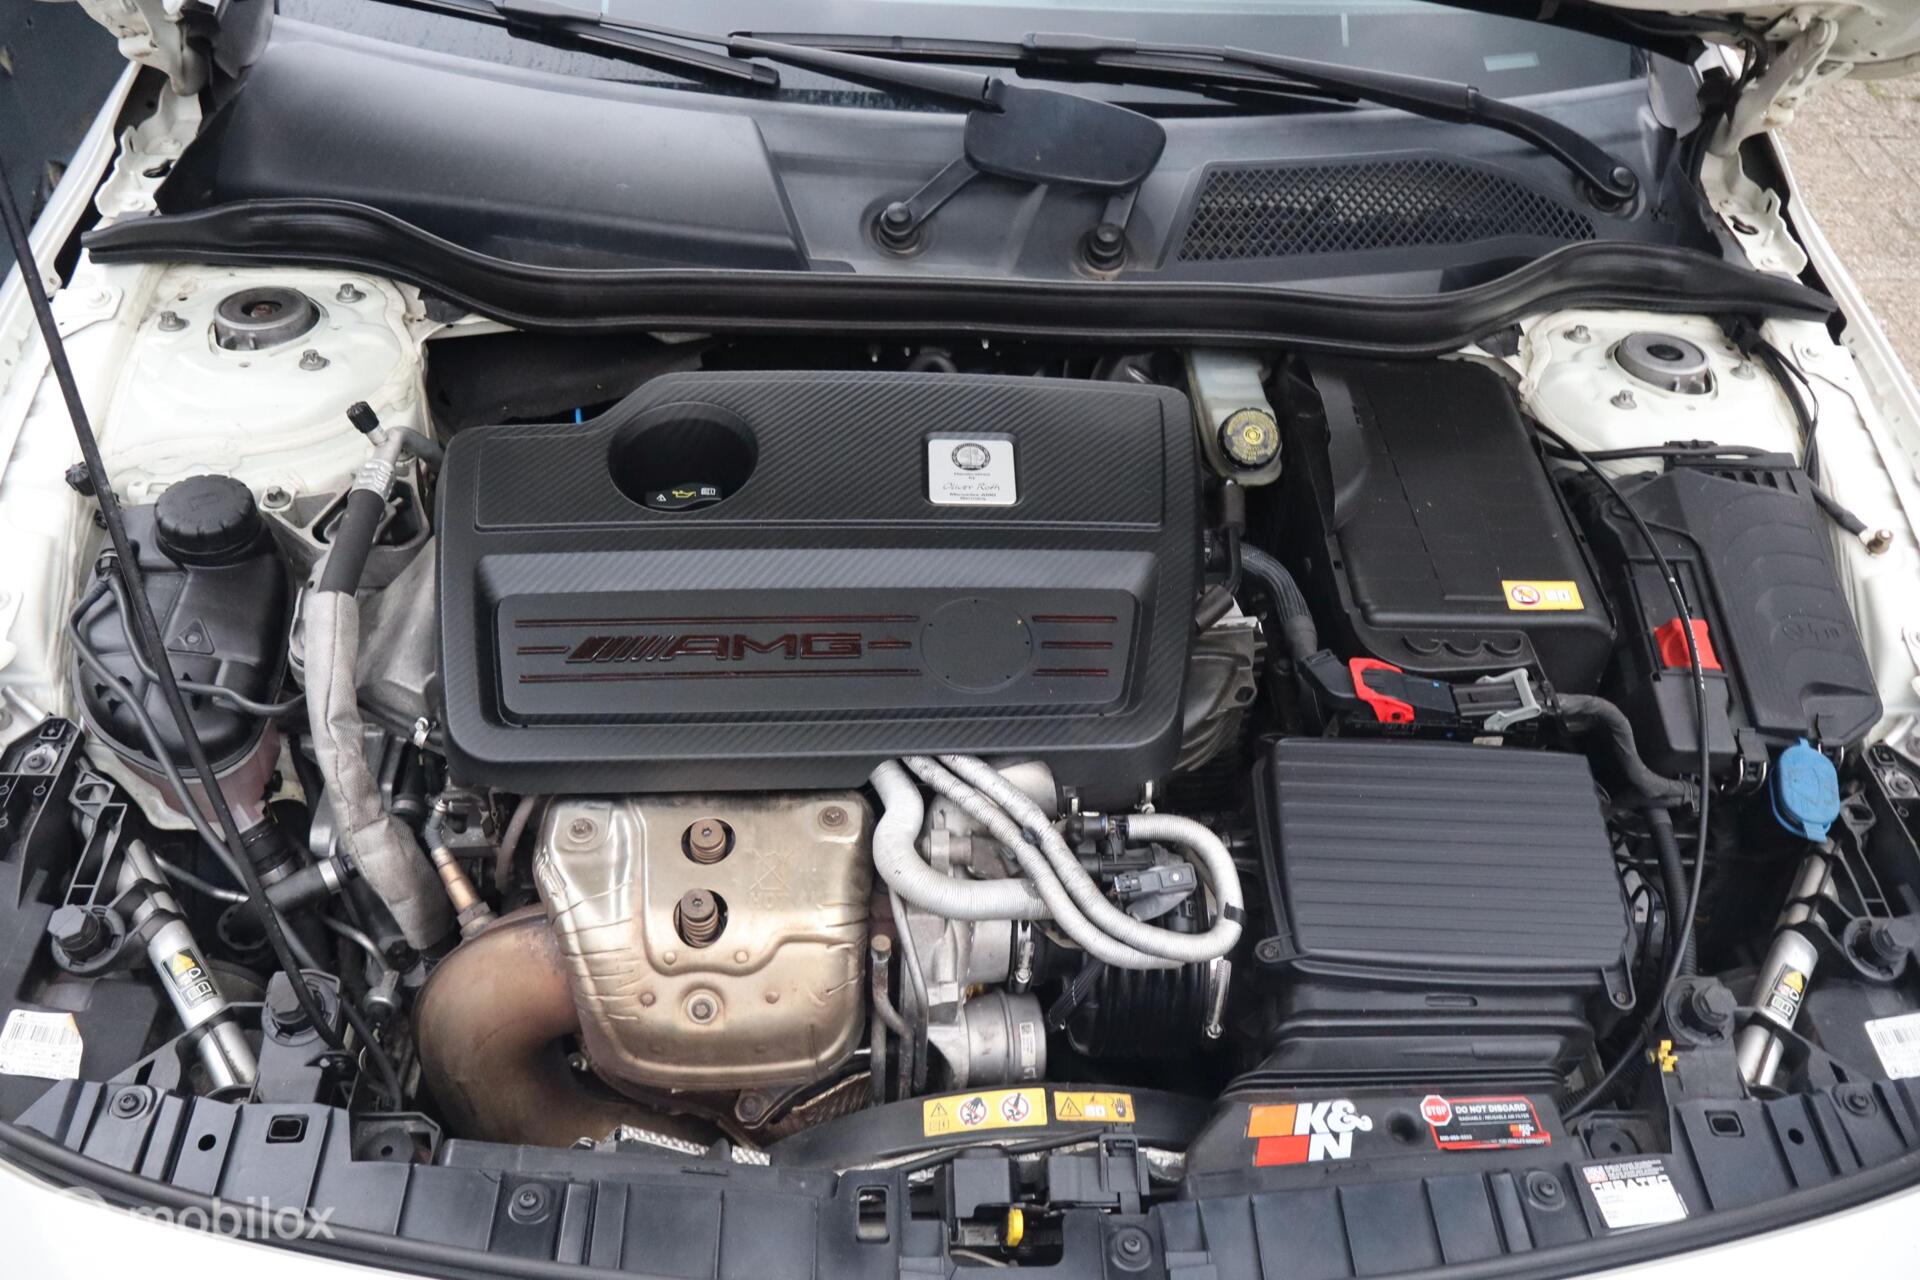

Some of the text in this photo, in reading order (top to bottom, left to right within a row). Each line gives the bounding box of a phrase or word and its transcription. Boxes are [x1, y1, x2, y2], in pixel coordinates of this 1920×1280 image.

[660, 633, 861, 662] AMG
[1425, 1104, 1447, 1116] STOP
[1455, 1105, 1468, 1114] DO
[1470, 1104, 1486, 1114] NOT
